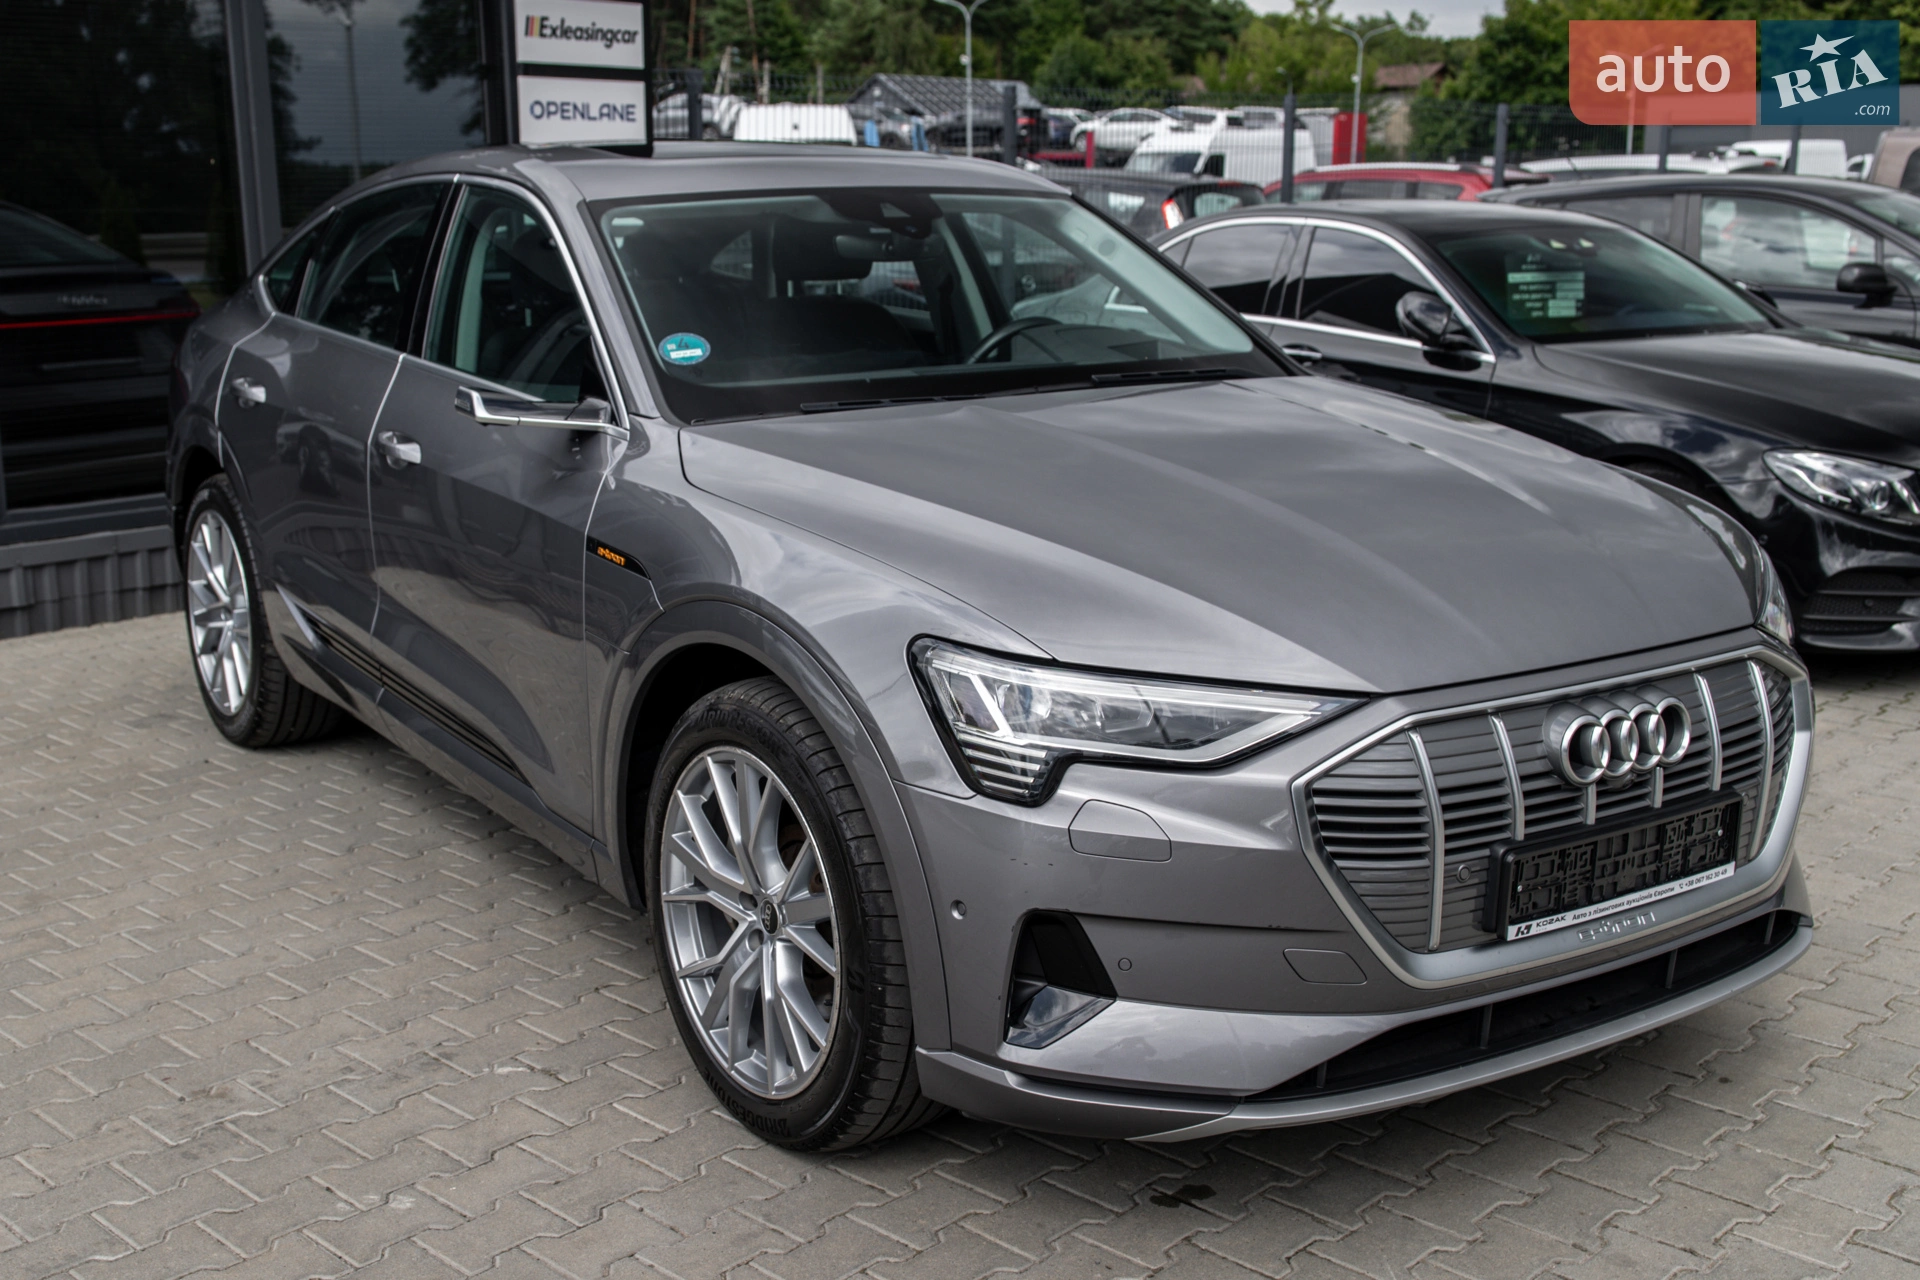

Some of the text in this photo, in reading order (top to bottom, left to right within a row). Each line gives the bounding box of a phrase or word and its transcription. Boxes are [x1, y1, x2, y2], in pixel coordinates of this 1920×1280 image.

[539, 15, 638, 50] Exleasingcar
[529, 100, 636, 122] OPENLANE
[1684, 879, 1694, 888] +38
[1694, 876, 1705, 885] 067
[1705, 873, 1714, 882] 162
[1713, 871, 1720, 879] 30
[1572, 912, 1588, 921] Авто
[1592, 902, 1625, 915] лізингових
[1625, 893, 1653, 906] аукціонів
[1653, 886, 1675, 898] Європи
[1535, 914, 1567, 928] KOZAK
